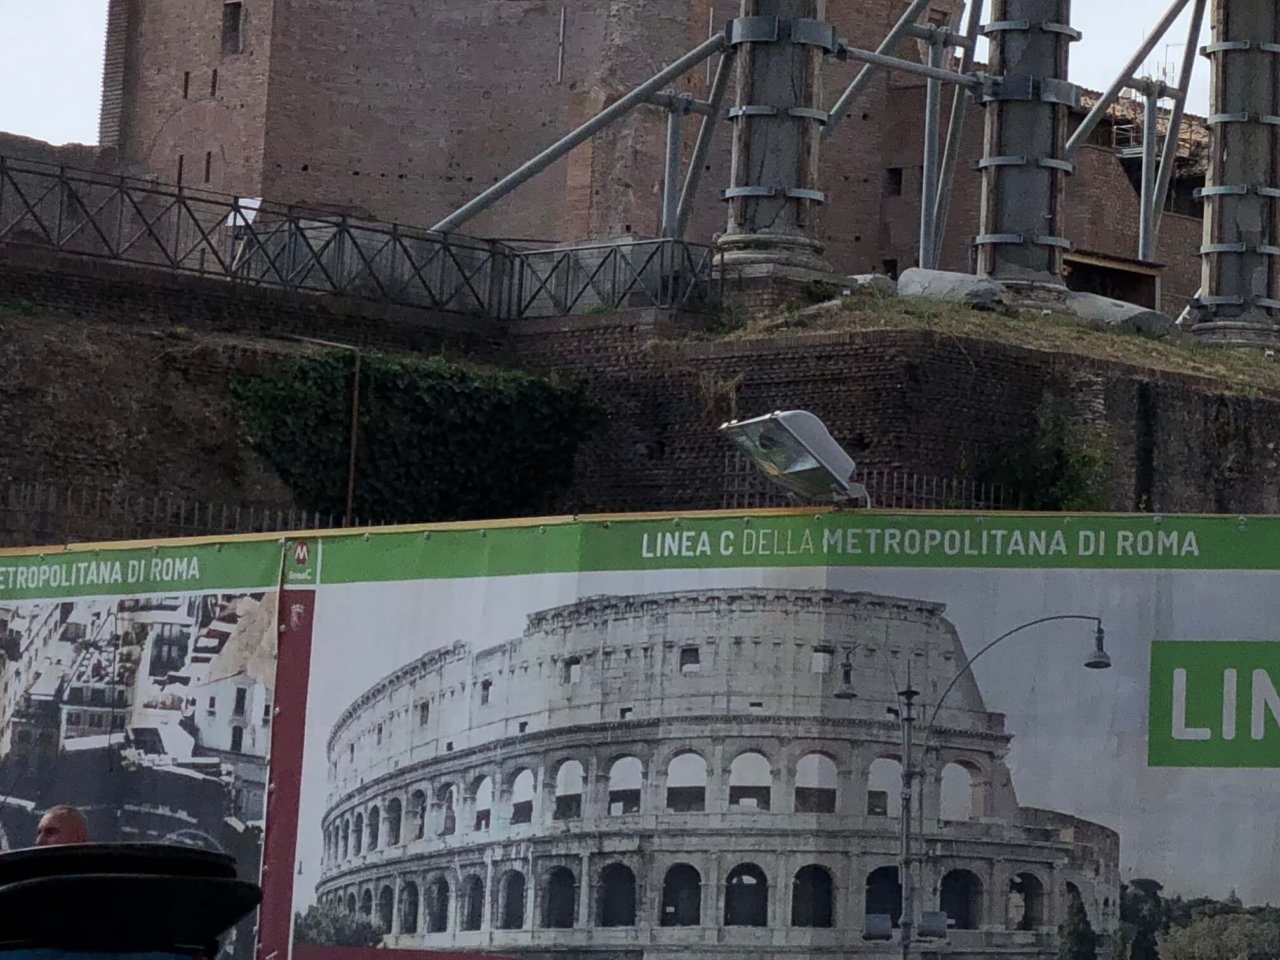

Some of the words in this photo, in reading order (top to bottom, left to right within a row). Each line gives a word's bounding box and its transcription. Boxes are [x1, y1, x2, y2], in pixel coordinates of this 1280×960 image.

[641, 531, 711, 558] LINEA
[719, 530, 735, 556] C
[742, 528, 814, 555] DELLA
[822, 528, 1068, 555] METROPOLITANA
[1078, 530, 1105, 556] DI
[1116, 530, 1200, 557] ROMA
[127, 559, 145, 583] DI
[151, 556, 200, 581] ROMA
